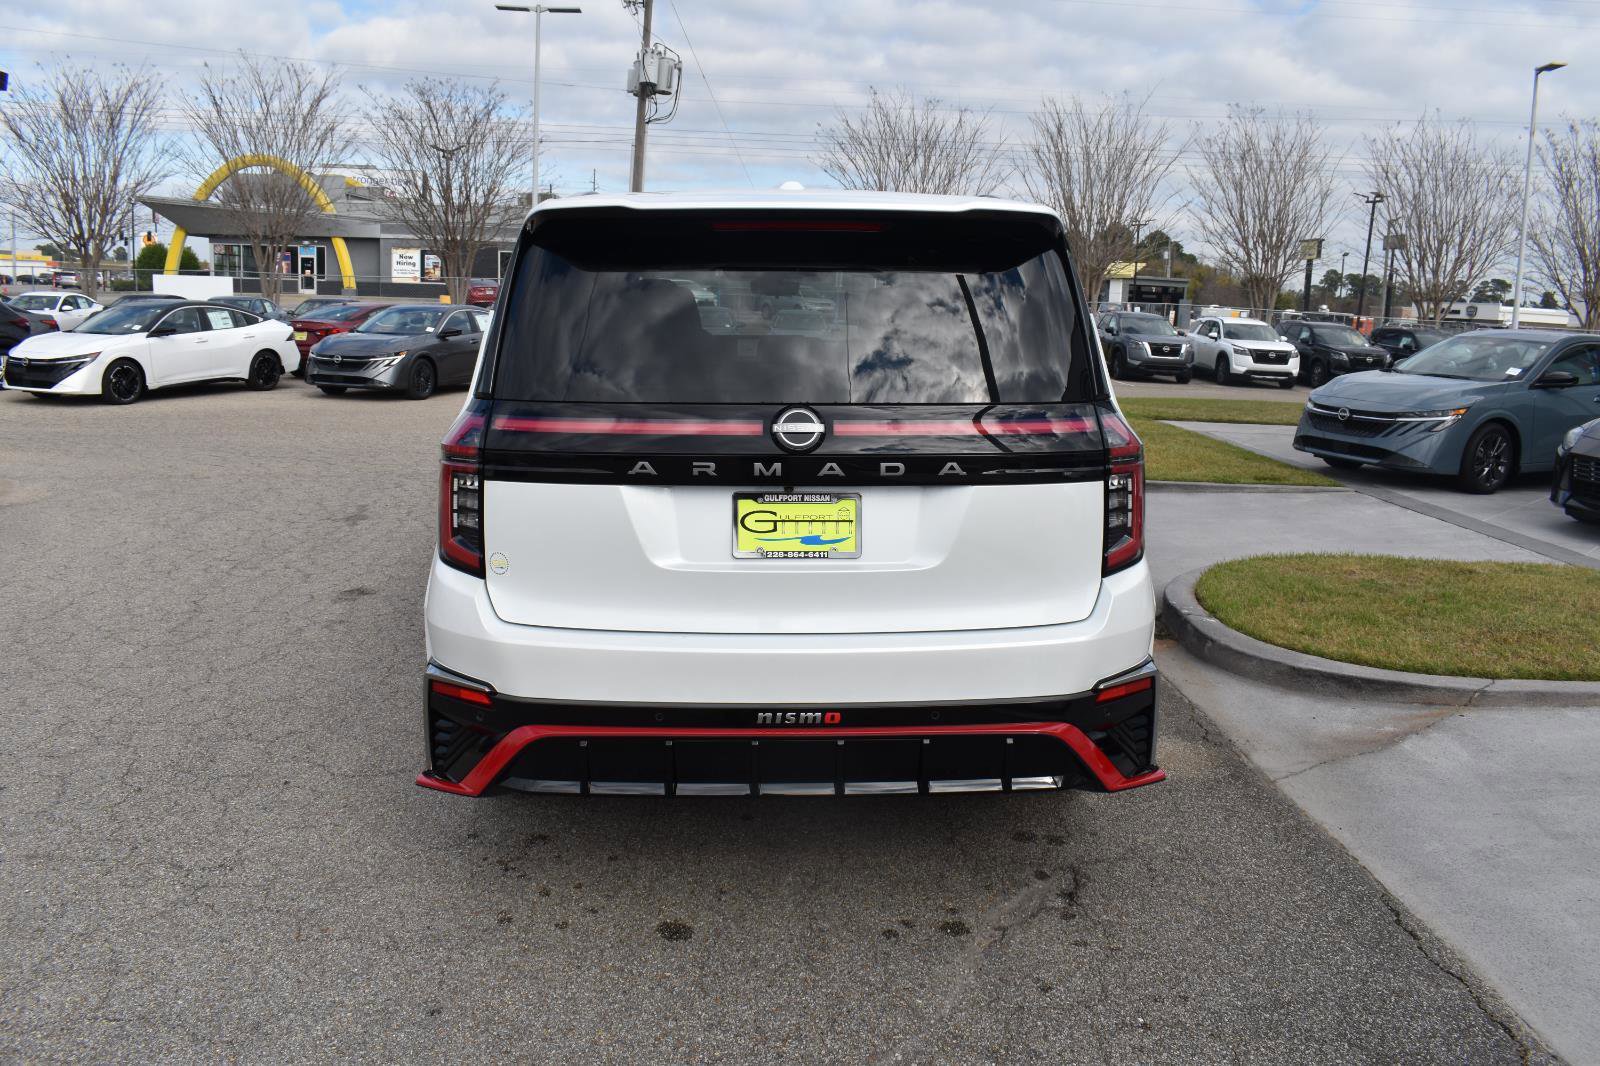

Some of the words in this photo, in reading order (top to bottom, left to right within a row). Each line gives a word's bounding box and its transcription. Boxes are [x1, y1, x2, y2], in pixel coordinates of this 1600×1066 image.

[628, 461, 967, 477] ARMADA
[764, 494, 802, 502] GULFPORT
[804, 494, 831, 502] NISSAN
[757, 711, 841, 724] nismo
